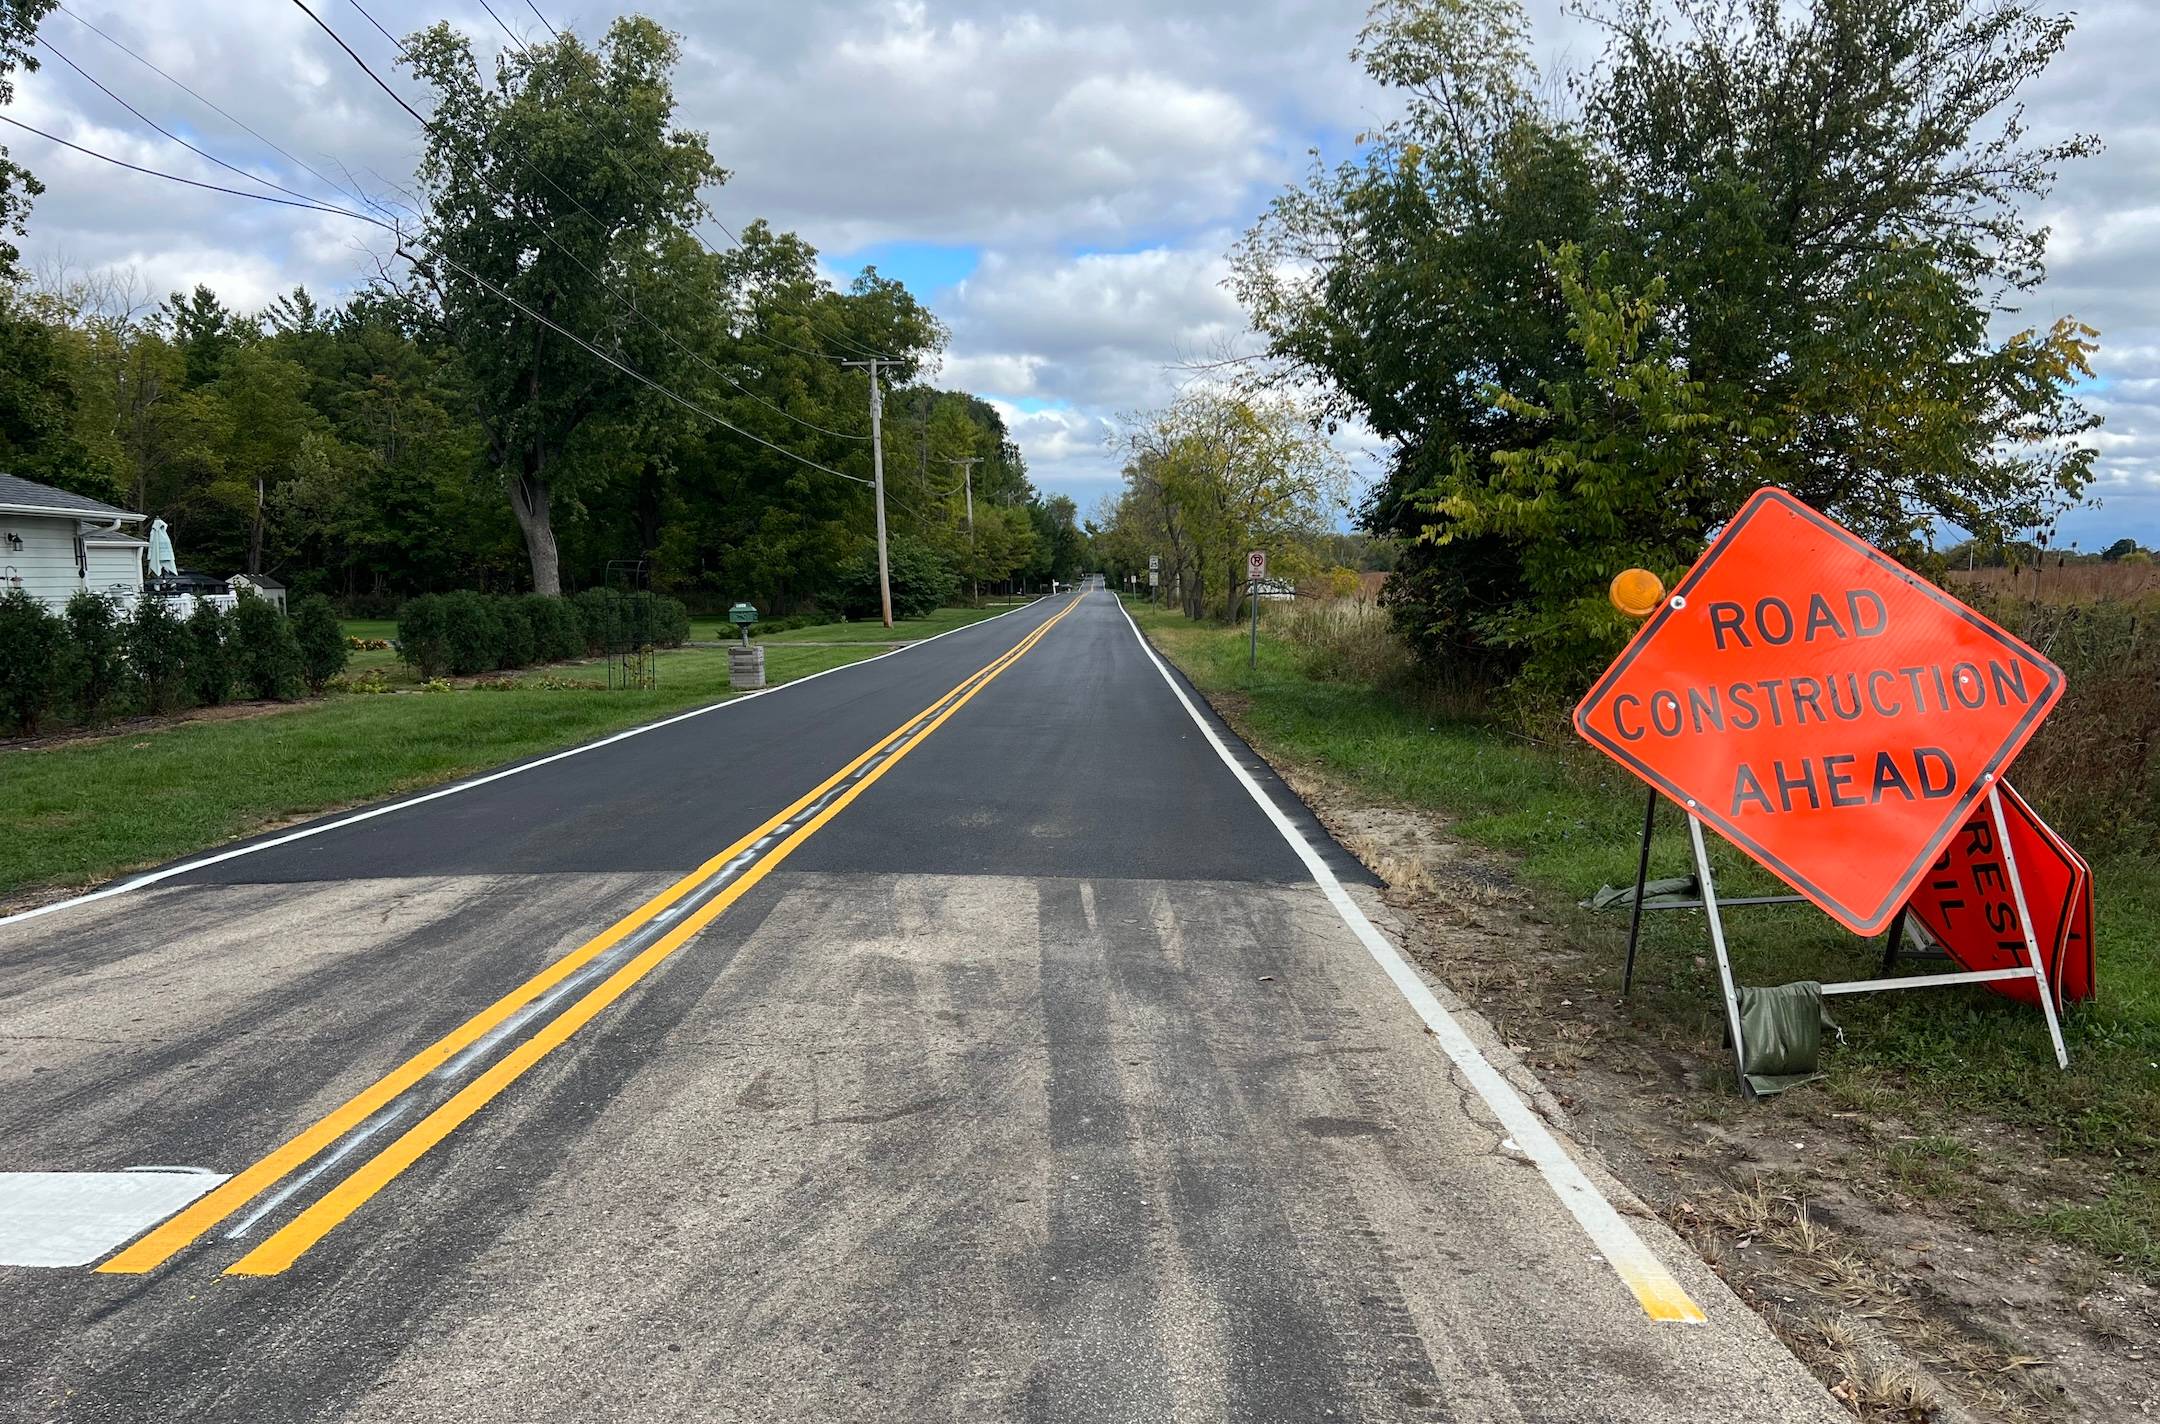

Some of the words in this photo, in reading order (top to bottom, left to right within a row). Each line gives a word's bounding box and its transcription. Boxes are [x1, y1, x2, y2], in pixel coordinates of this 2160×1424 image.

[1709, 589, 1889, 650] ROAD
[1612, 658, 2030, 741] CONSTRUCTION
[1730, 746, 1958, 817] AHEAD
[1962, 803, 2027, 967] RESH
